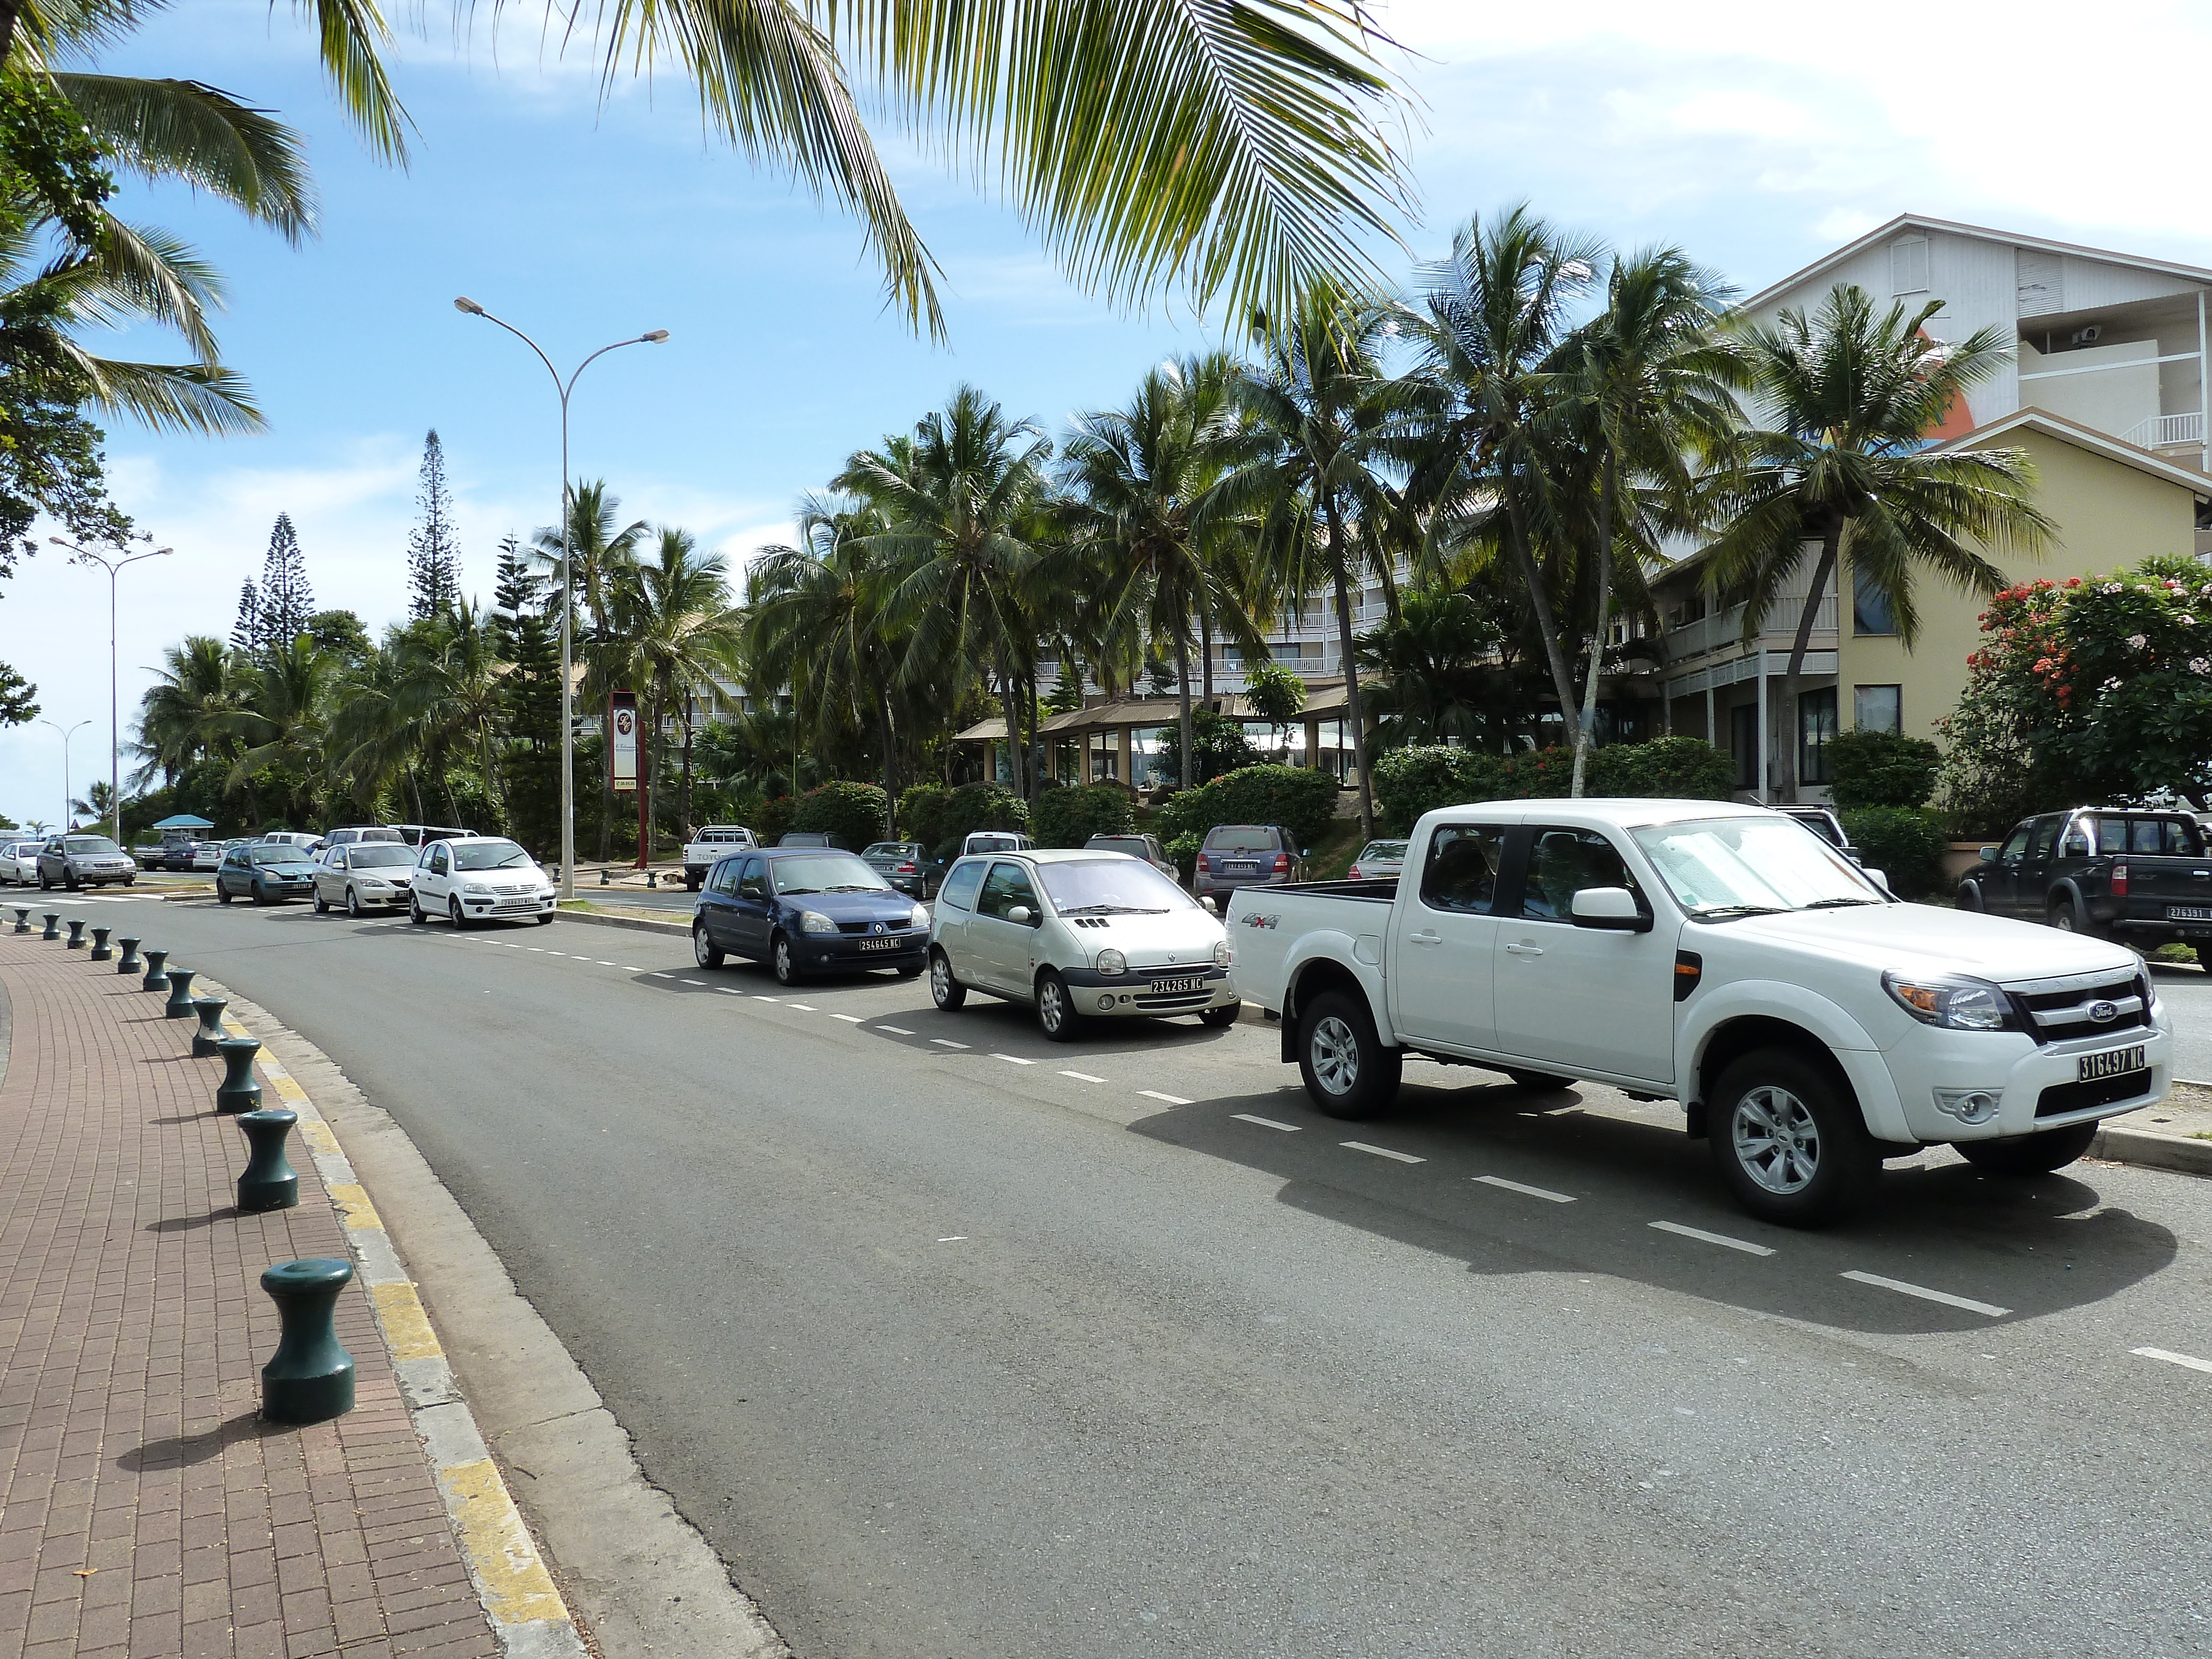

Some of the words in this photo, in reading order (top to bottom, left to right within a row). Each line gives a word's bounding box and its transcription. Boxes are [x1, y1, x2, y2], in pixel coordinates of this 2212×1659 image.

[2171, 908, 2202, 917] 276391
[862, 940, 888, 950] 254645
[1154, 979, 1188, 992] 234265
[1191, 978, 1201, 989] NC
[2027, 969, 2132, 990] RANGER
[2095, 1005, 2112, 1017] Ford
[2081, 1050, 2126, 1079] 316497
[2130, 1047, 2143, 1069] NC
